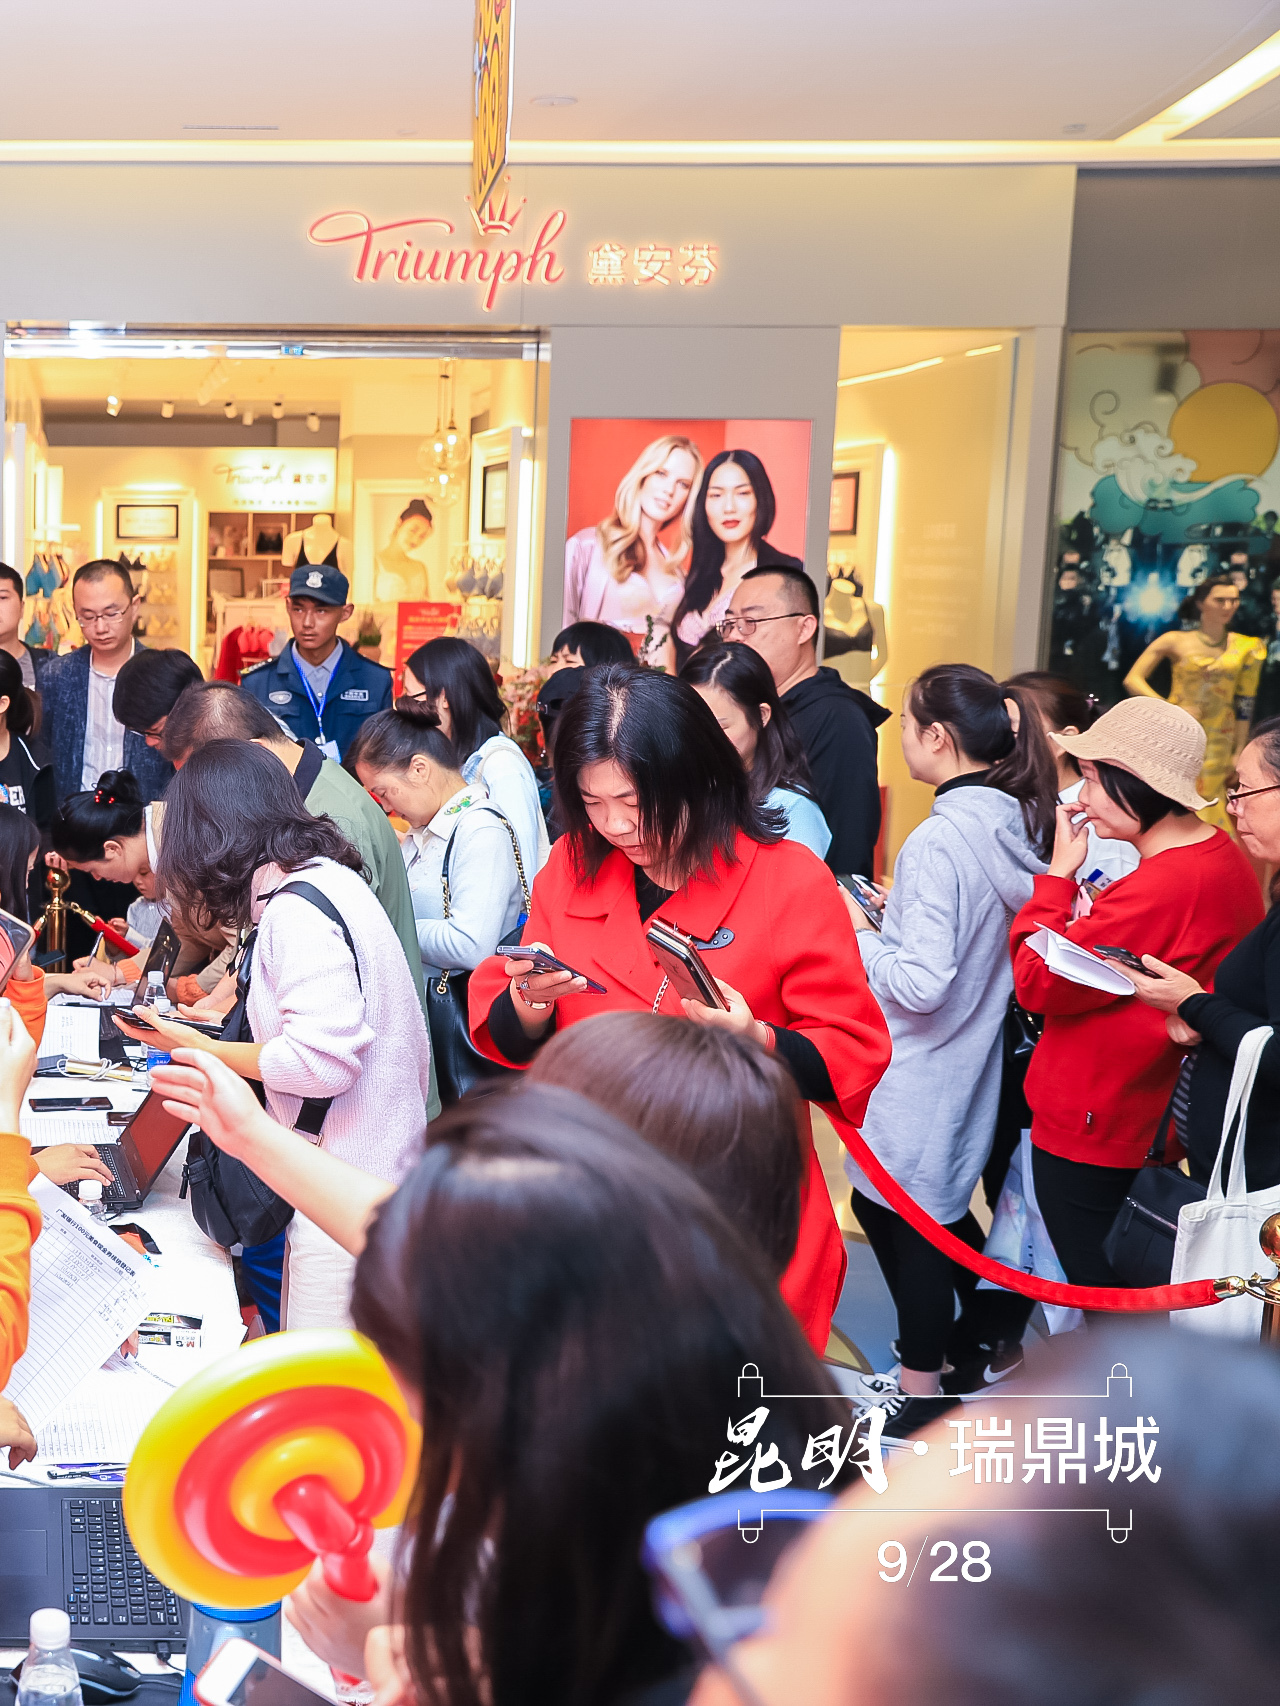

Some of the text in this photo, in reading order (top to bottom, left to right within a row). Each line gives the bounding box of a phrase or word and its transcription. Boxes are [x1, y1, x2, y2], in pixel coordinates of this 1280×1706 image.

[307, 210, 568, 312] Triumph
[588, 243, 720, 286] 黛安芬
